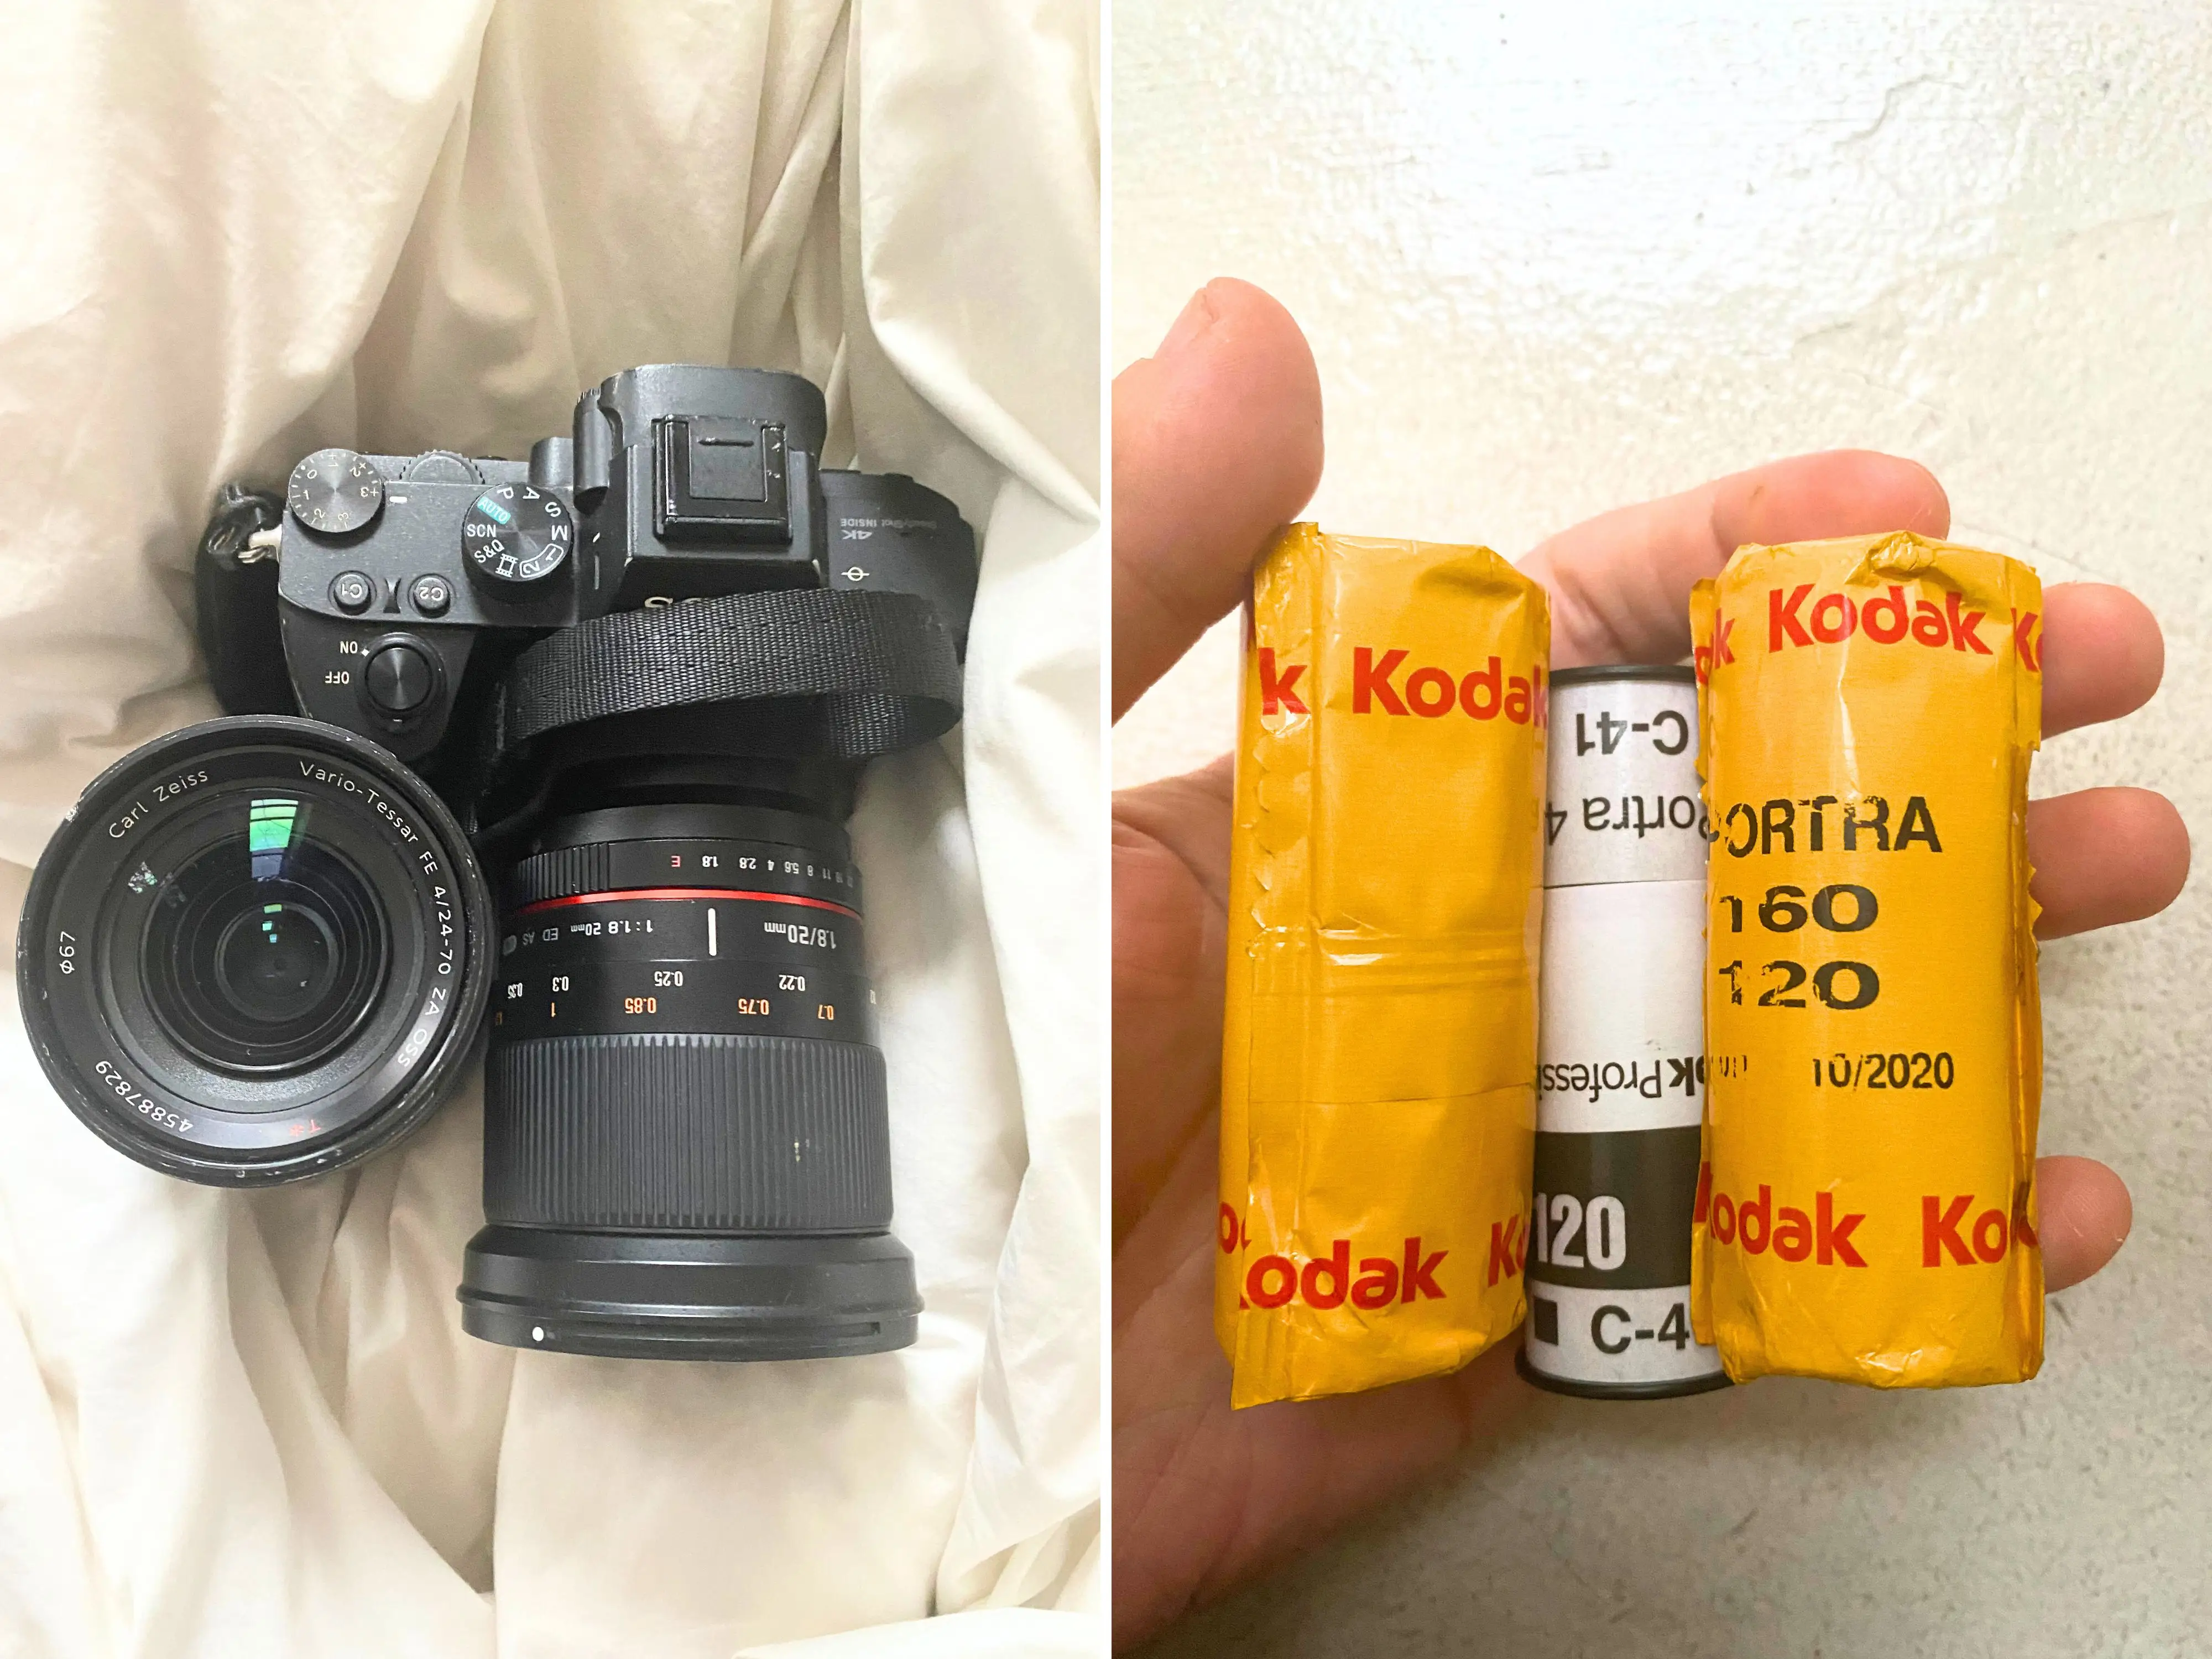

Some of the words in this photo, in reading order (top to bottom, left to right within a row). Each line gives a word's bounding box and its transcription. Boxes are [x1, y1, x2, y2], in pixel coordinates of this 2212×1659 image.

[497, 486, 514, 499] P
[522, 486, 540, 500] A
[477, 498, 509, 524] AUTO
[544, 502, 561, 518] S
[466, 524, 497, 538] SCN
[840, 518, 877, 528] INSIDE
[551, 525, 568, 541] M
[841, 529, 873, 540] 4K
[473, 539, 505, 564] S&Q
[341, 583, 363, 598] C1
[419, 586, 444, 601] C2
[1768, 583, 1994, 656] Kodak
[340, 640, 358, 654] ON
[324, 671, 350, 685] OFF
[1352, 646, 1548, 729] Kodak
[1575, 709, 1689, 756] C-41
[109, 801, 149, 838] Carl
[153, 770, 208, 802] Zeiss
[300, 761, 418, 843] Vario-Tessar
[1715, 795, 1943, 858] ORTRA
[419, 851, 439, 875] FE
[670, 855, 681, 868] E
[701, 855, 718, 868] 1.8
[738, 857, 757, 870] 2.8
[766, 859, 775, 872] 4
[784, 860, 800, 874] 5.6
[1719, 884, 1879, 932] 160
[434, 885, 453, 975] 4/24-70
[542, 927, 559, 941] ED
[570, 922, 602, 936] 20mm
[763, 921, 837, 950] 1.8/20mm
[552, 975, 569, 992] 0.3
[654, 970, 684, 987] 0.25
[778, 974, 806, 992] 0.22
[1718, 959, 1880, 1010] 120
[425, 987, 446, 1016] ZA
[624, 997, 657, 1014] 0.85
[738, 998, 770, 1015] 0.75
[817, 1004, 835, 1021] 0.7
[397, 1028, 427, 1067] OSS
[1812, 1052, 1954, 1092] 10/2020
[95, 1060, 194, 1133] 45887829
[1533, 1192, 1626, 1270] 120
[1239, 1236, 1449, 1311] odak
